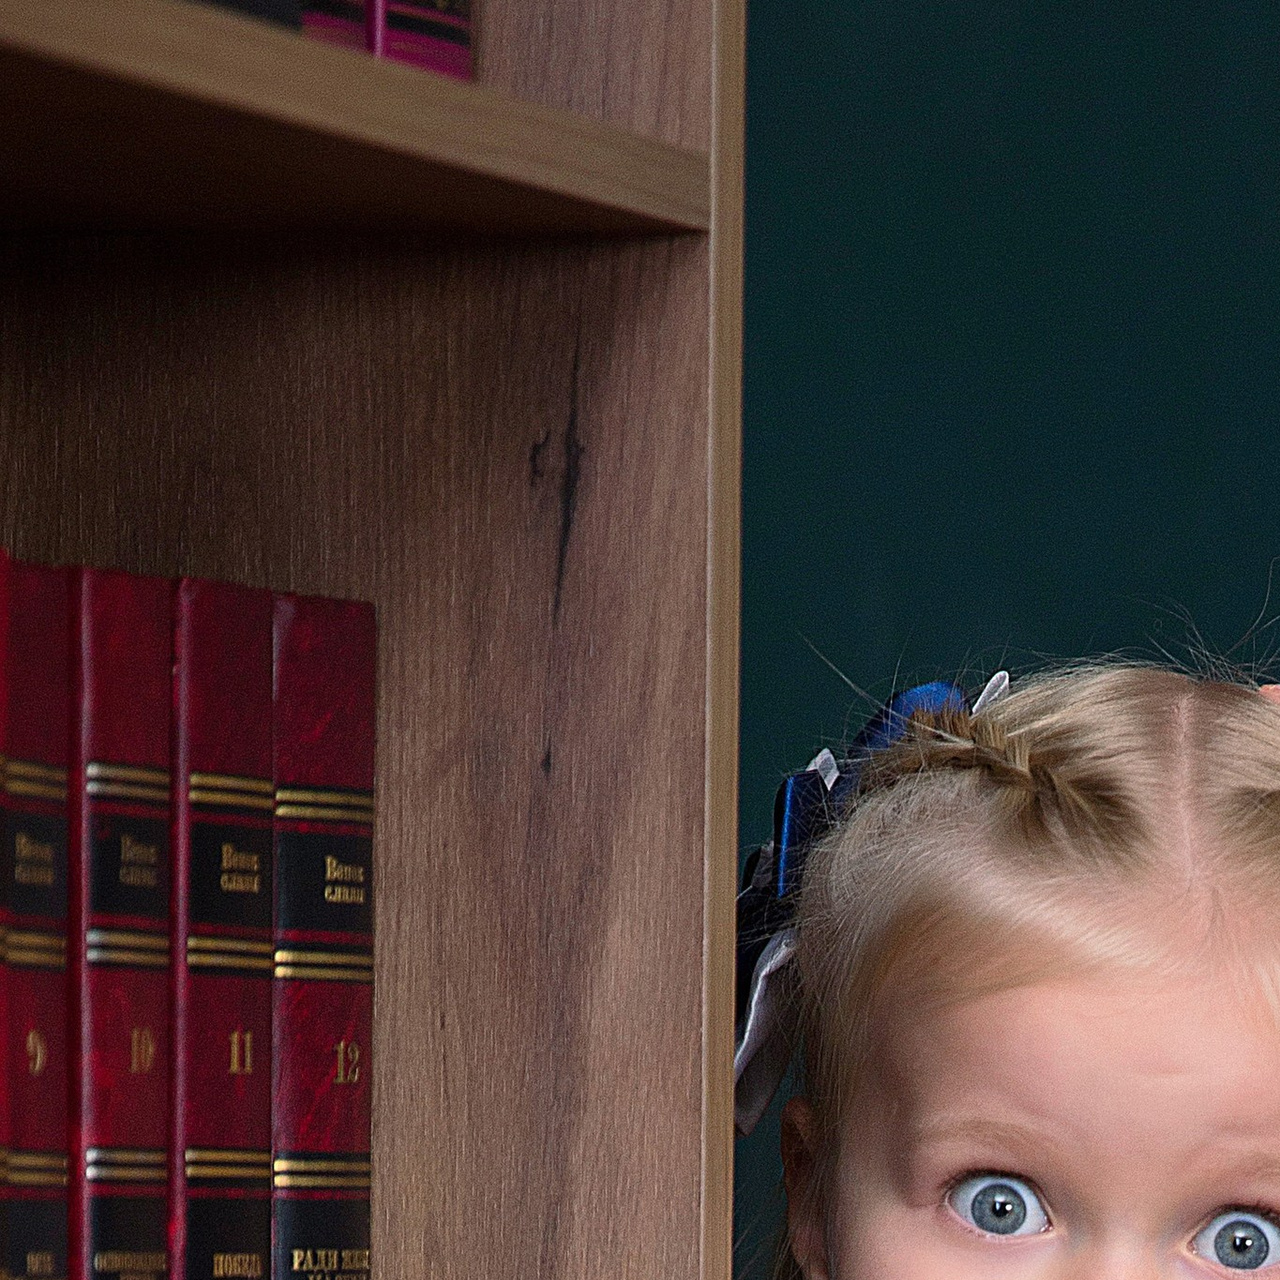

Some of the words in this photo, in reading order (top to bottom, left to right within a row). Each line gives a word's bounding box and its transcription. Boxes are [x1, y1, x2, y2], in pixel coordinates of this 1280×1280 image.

[229, 1030, 253, 1075] 11
[332, 1038, 361, 1084] 12
[292, 1248, 339, 1271] РАДИ
